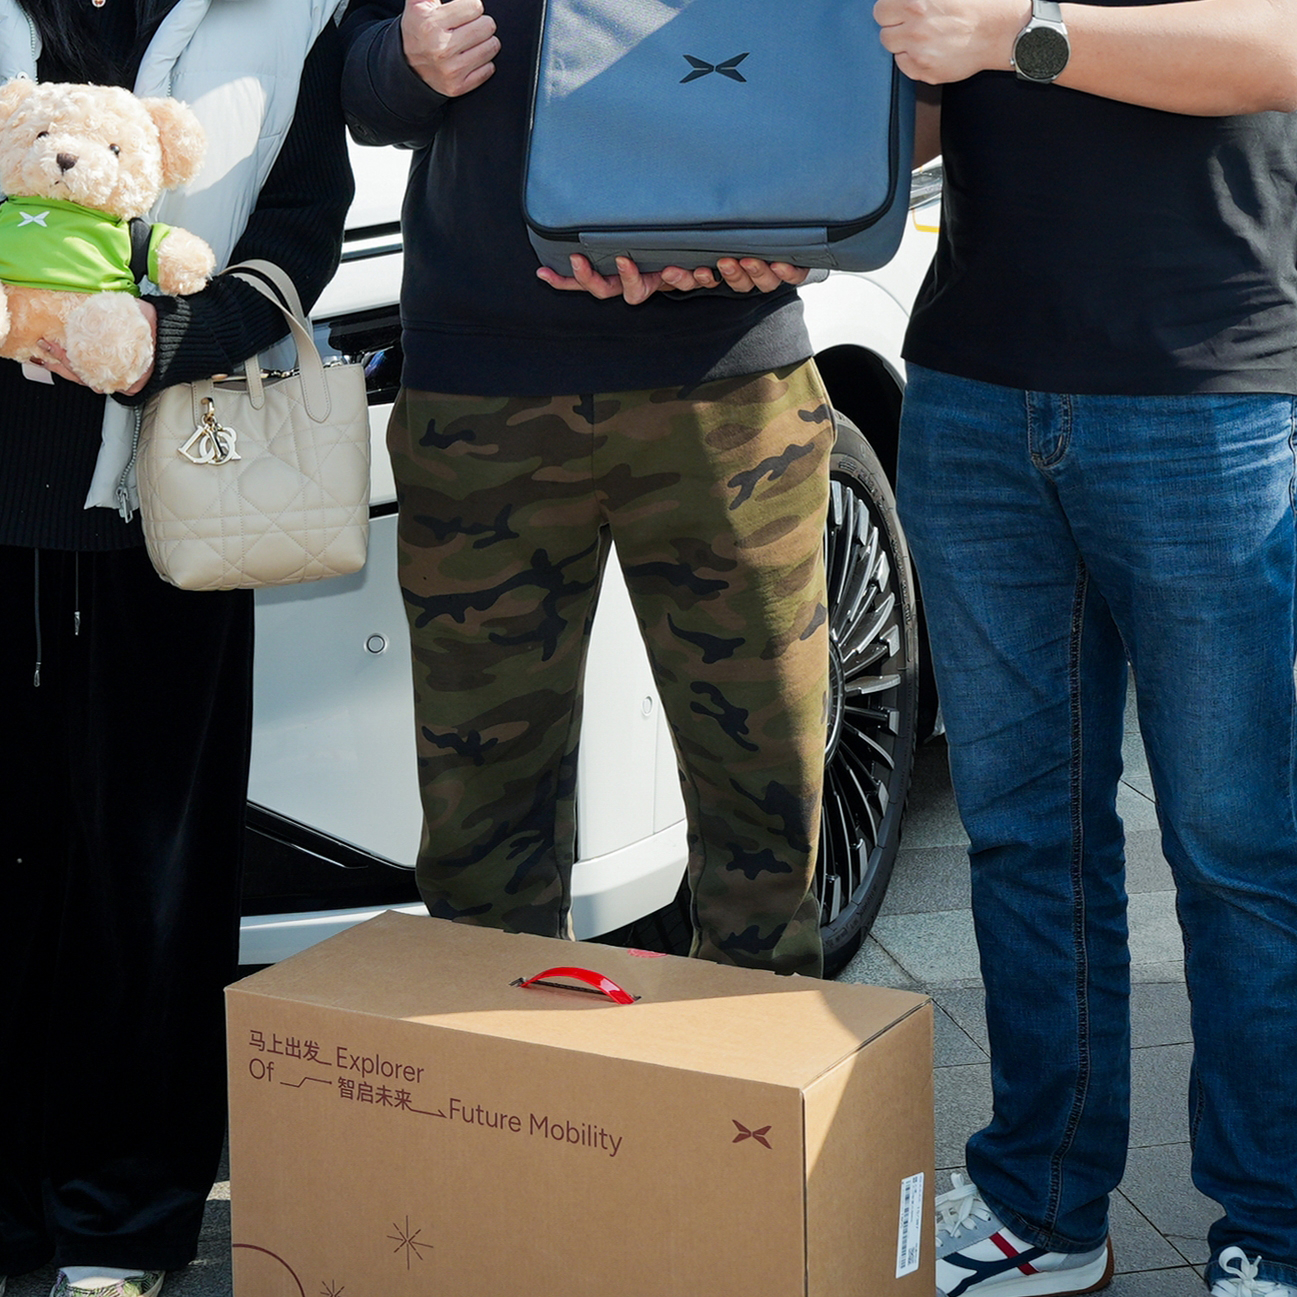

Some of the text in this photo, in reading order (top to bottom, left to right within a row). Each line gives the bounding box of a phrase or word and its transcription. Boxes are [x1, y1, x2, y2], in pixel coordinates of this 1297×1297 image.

[249, 1029, 425, 1083] 马上出发 Explorer
[249, 1057, 623, 1158] Of 智启未来 Future Mobility
